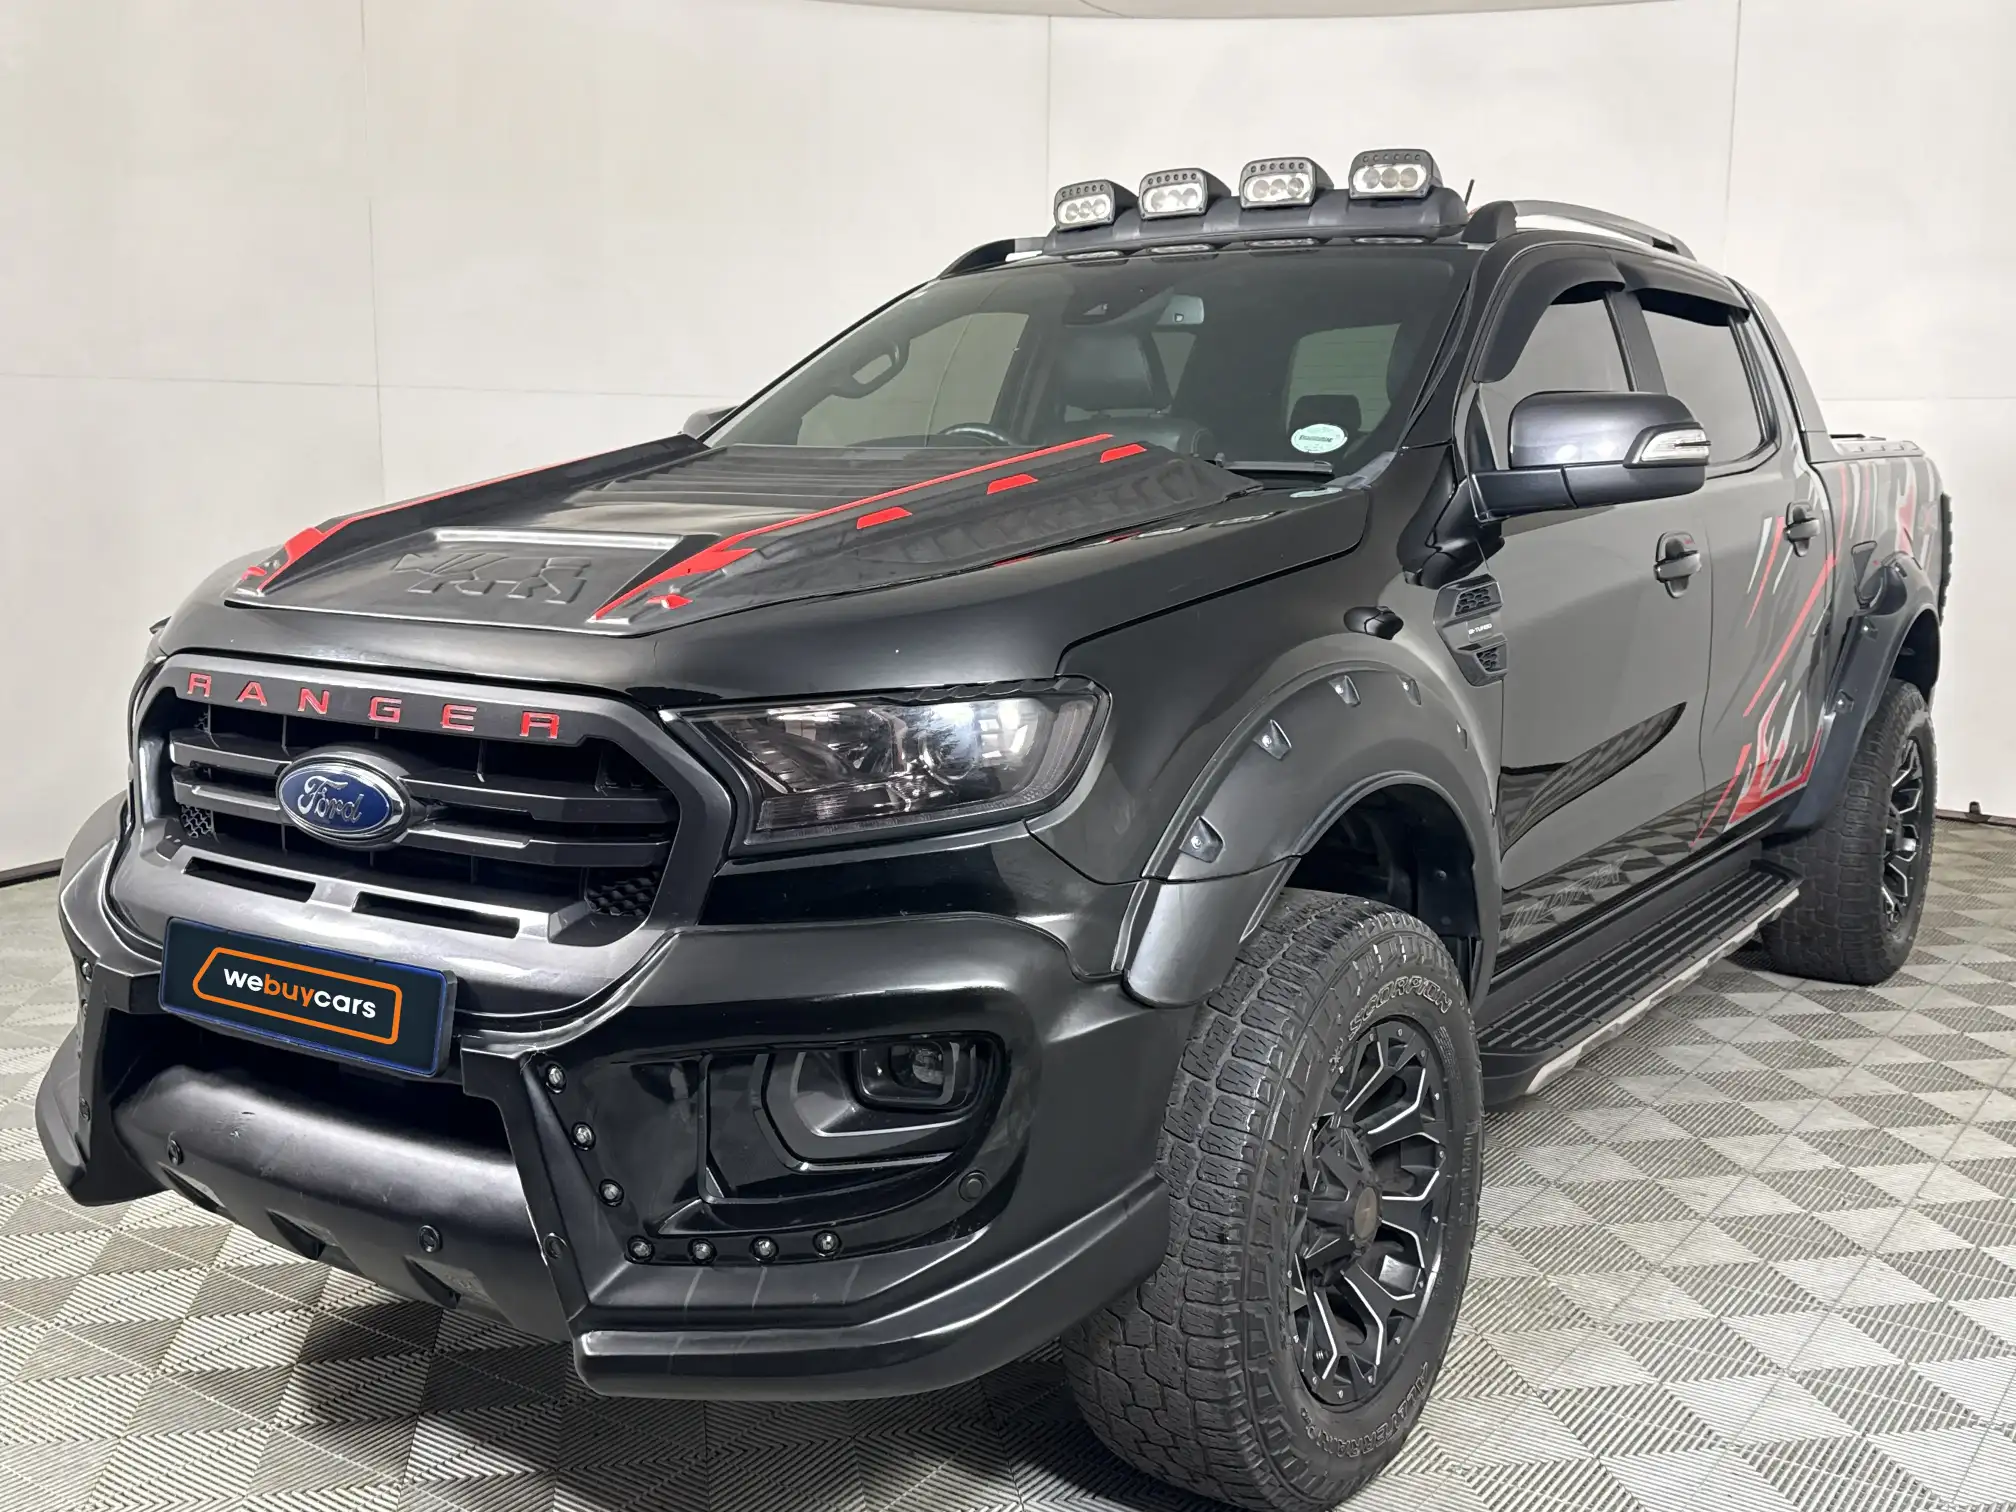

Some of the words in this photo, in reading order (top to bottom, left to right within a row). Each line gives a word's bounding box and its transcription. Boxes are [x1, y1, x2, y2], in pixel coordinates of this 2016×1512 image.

[186, 672, 561, 739] RANGER
[297, 775, 364, 824] Ford
[223, 968, 376, 1019] webuycars
[1348, 975, 1452, 1041] SCORPION
